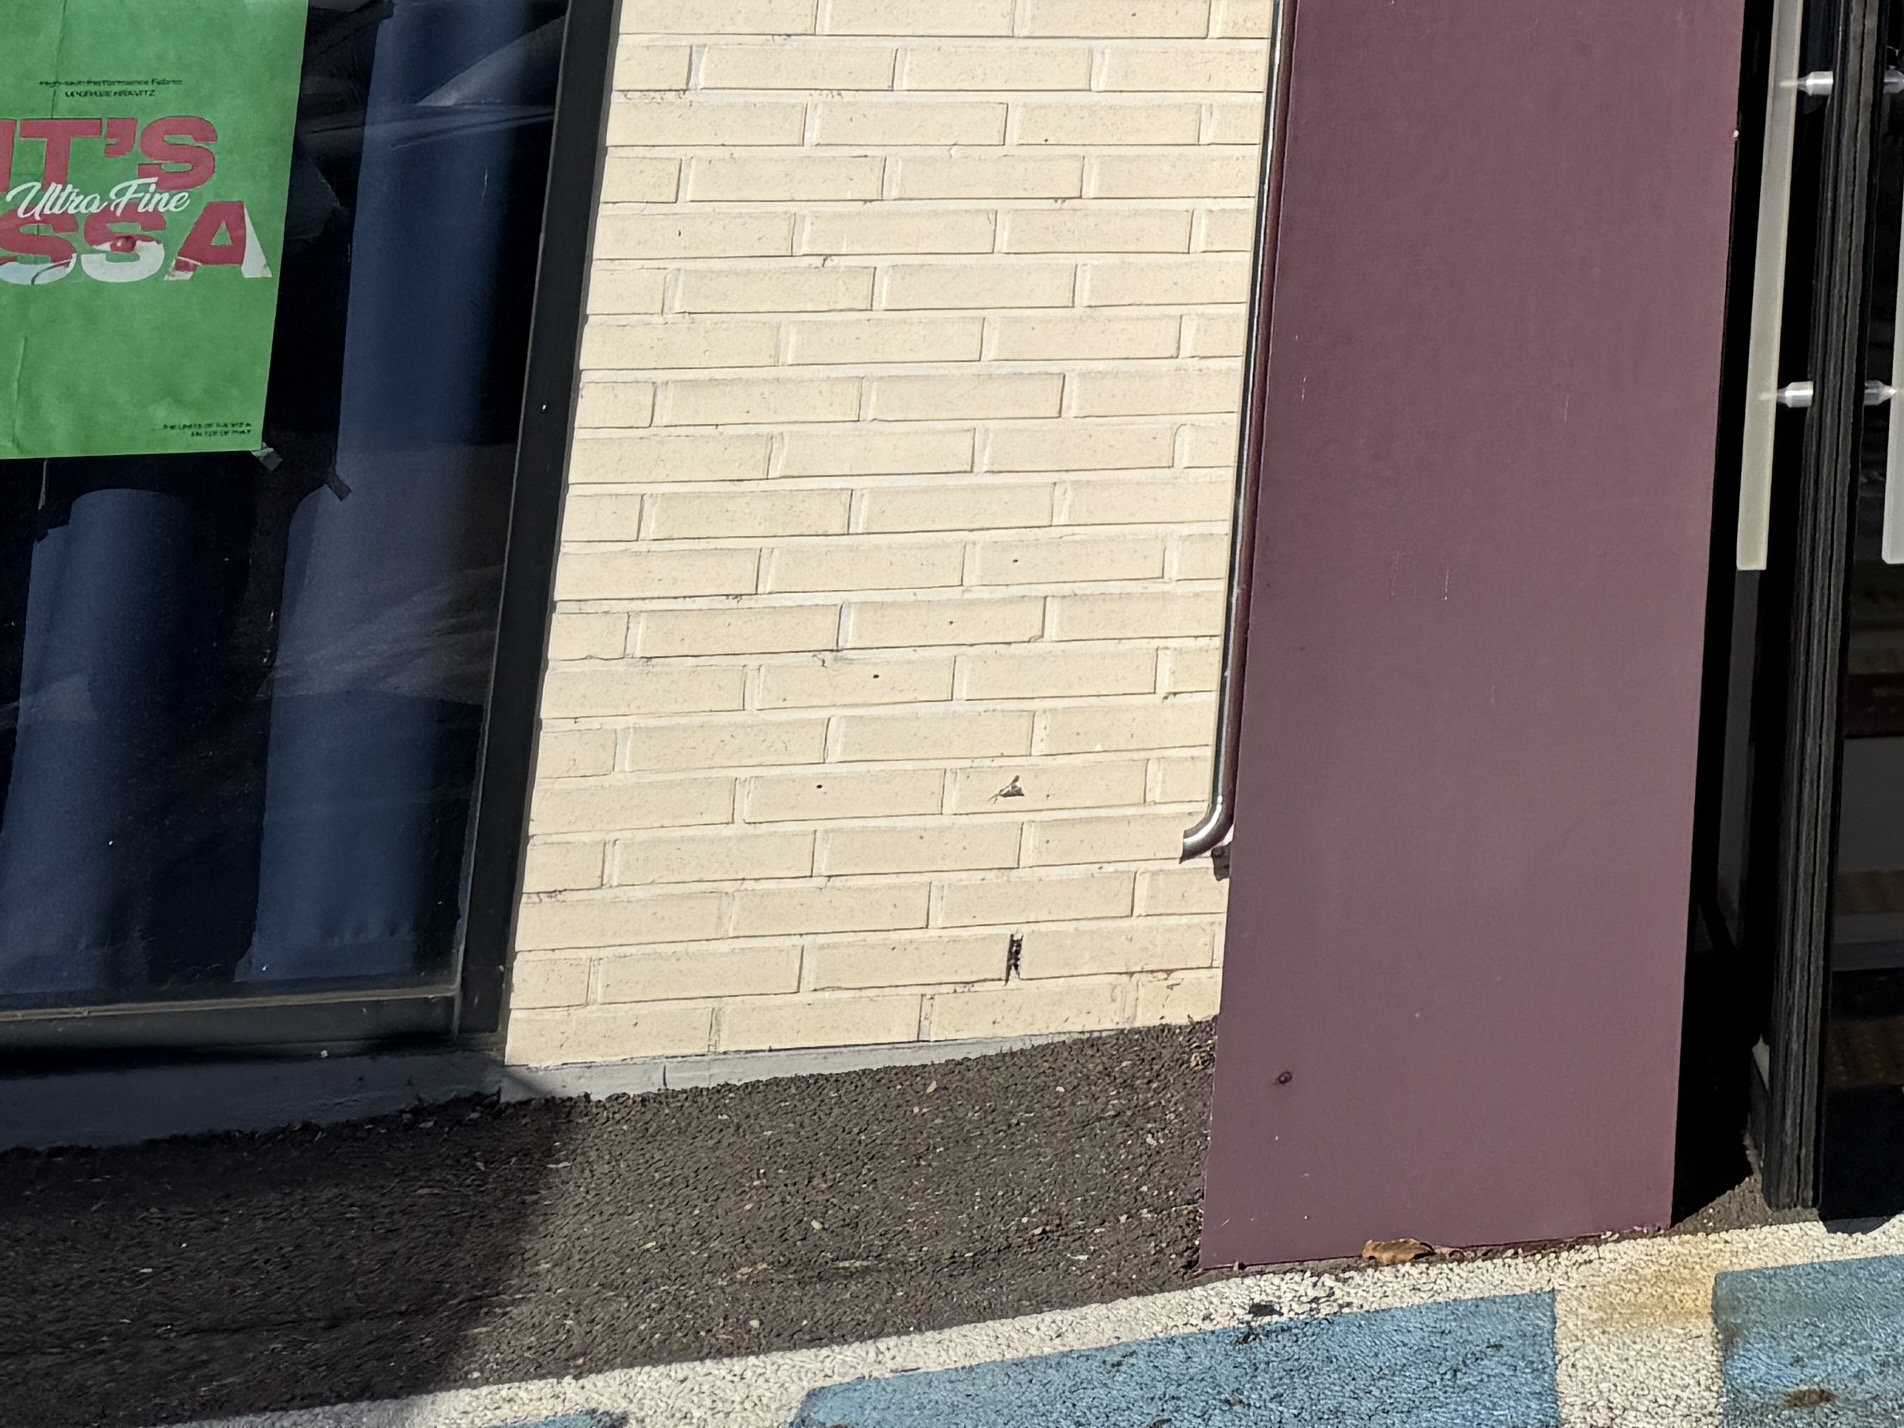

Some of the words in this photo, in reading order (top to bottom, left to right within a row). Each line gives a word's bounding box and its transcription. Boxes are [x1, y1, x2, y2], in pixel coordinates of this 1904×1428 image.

[6, 181, 110, 220] Ultra
[109, 177, 190, 216] Fine
[0, 200, 273, 286] SSA
